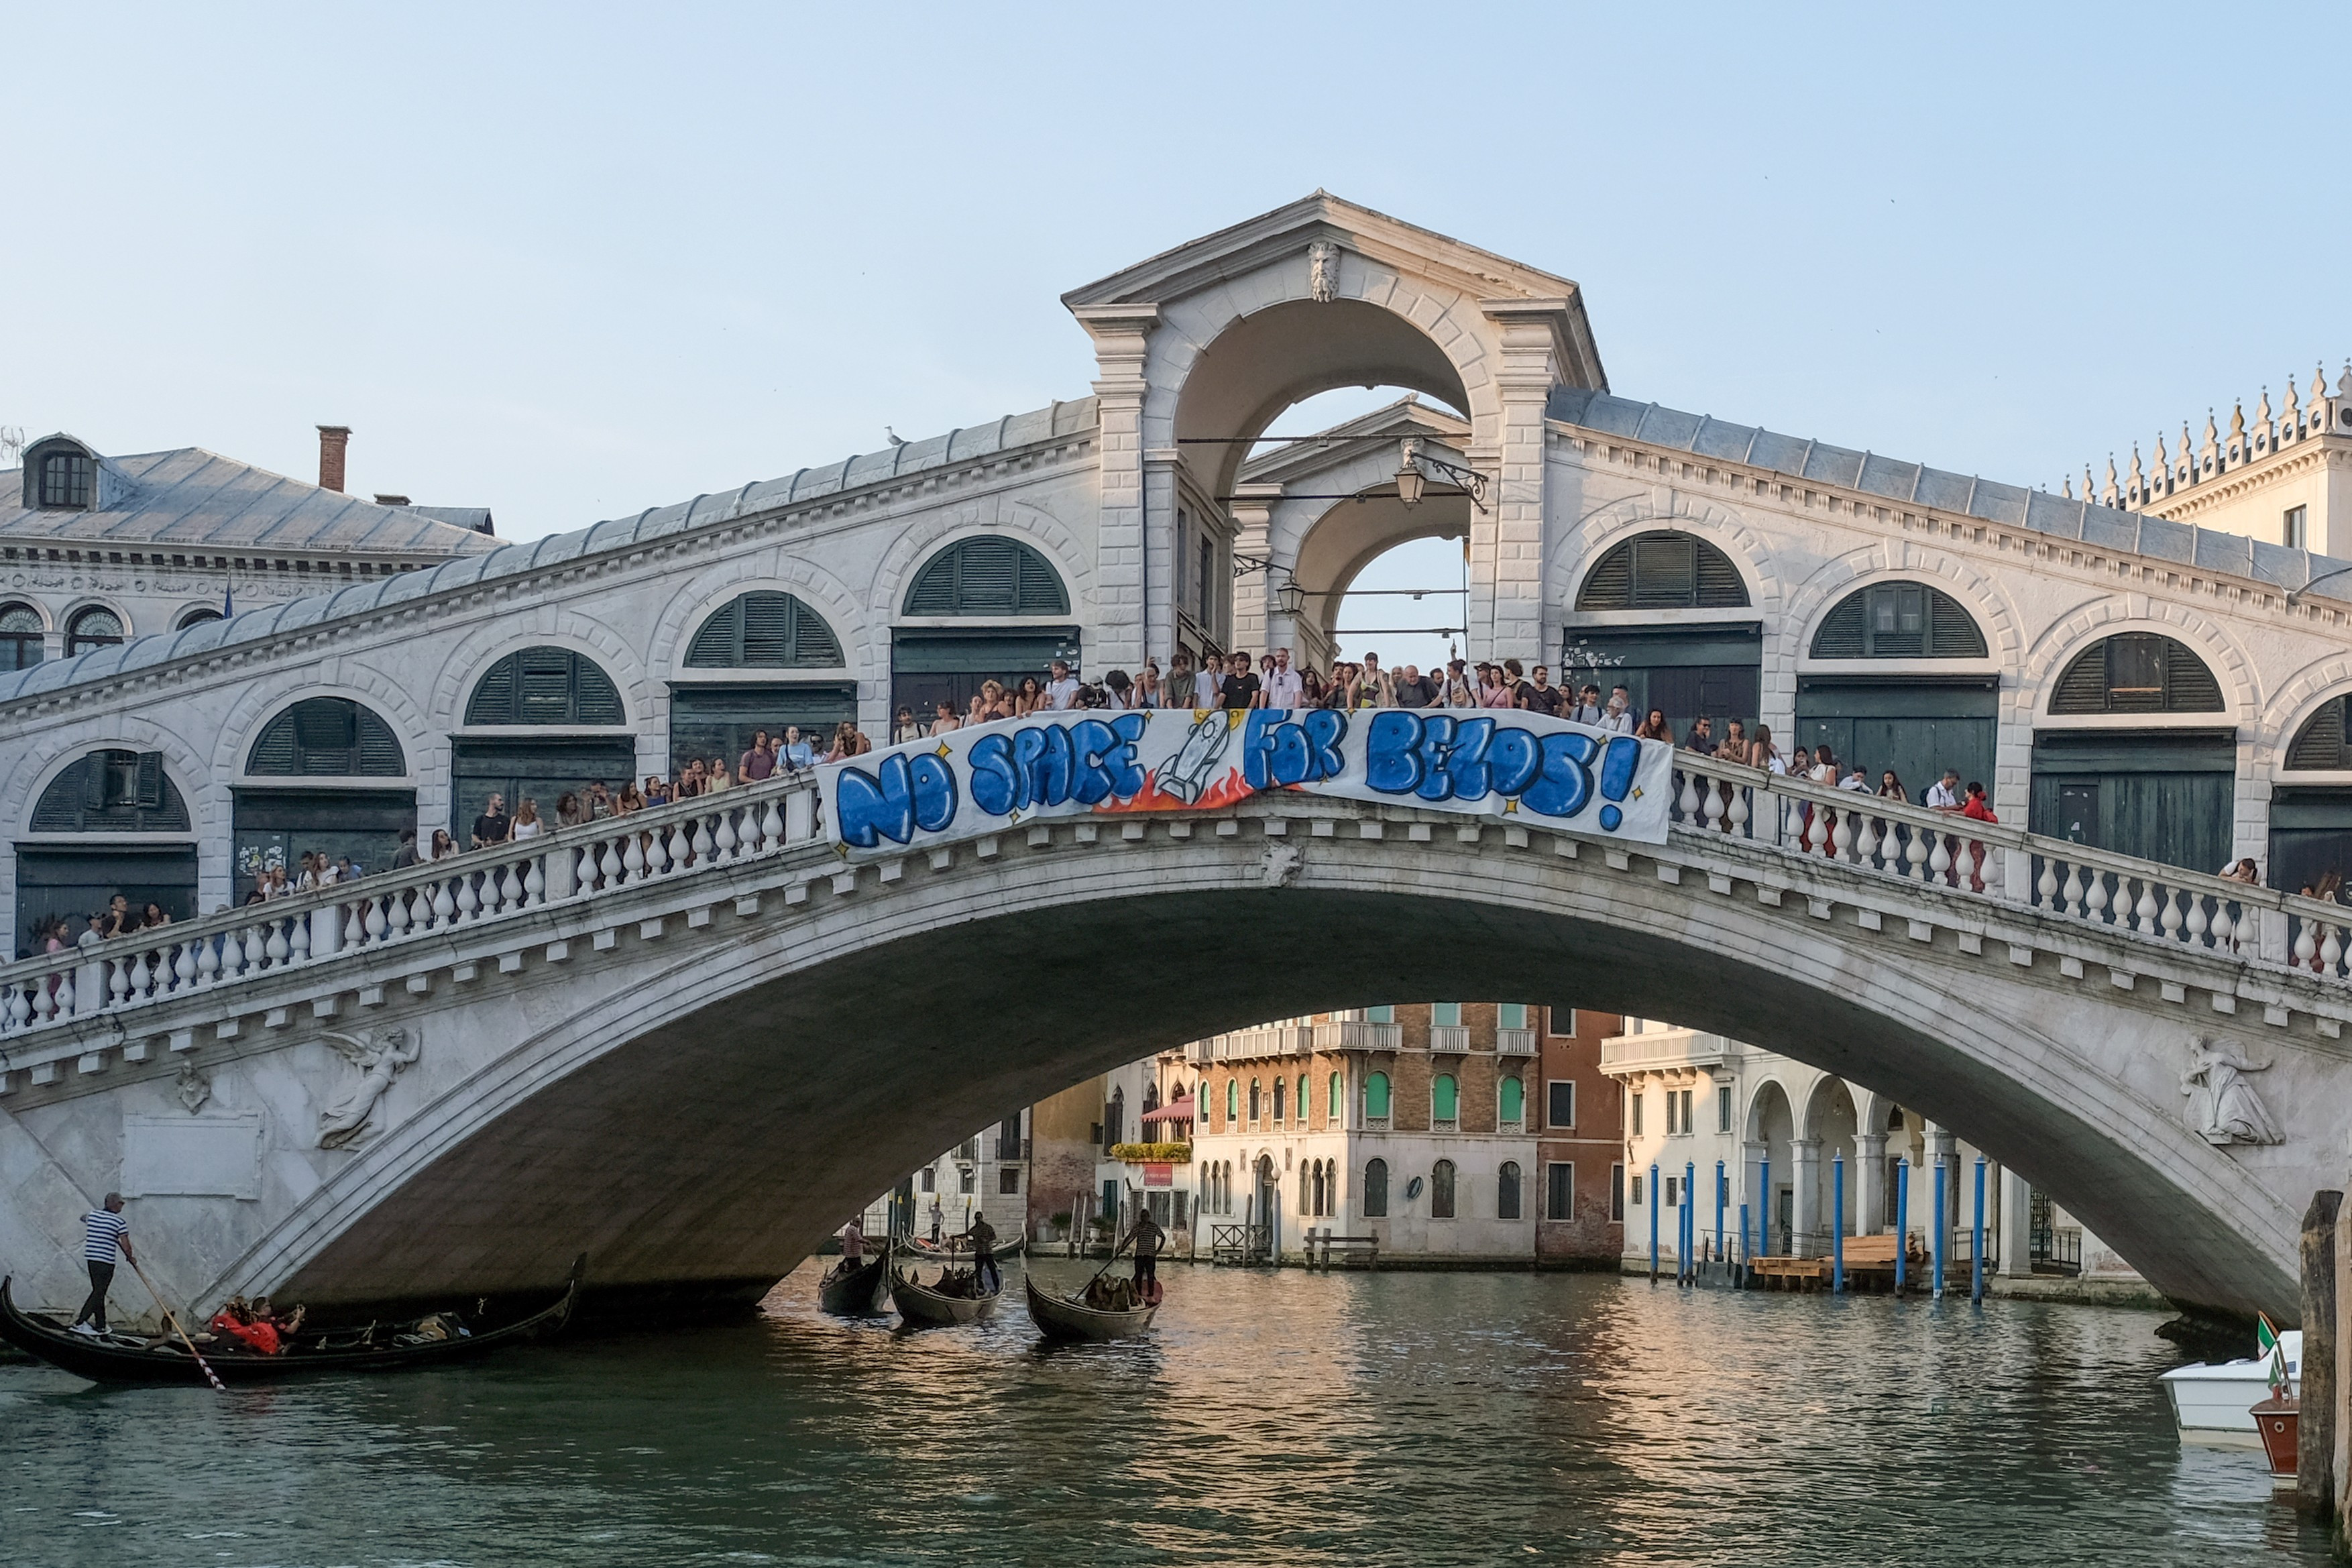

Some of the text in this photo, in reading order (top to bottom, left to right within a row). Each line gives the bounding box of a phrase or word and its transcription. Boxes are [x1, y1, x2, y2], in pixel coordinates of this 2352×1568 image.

[836, 708, 1642, 848] NO SPACE FOR BEZOS!
